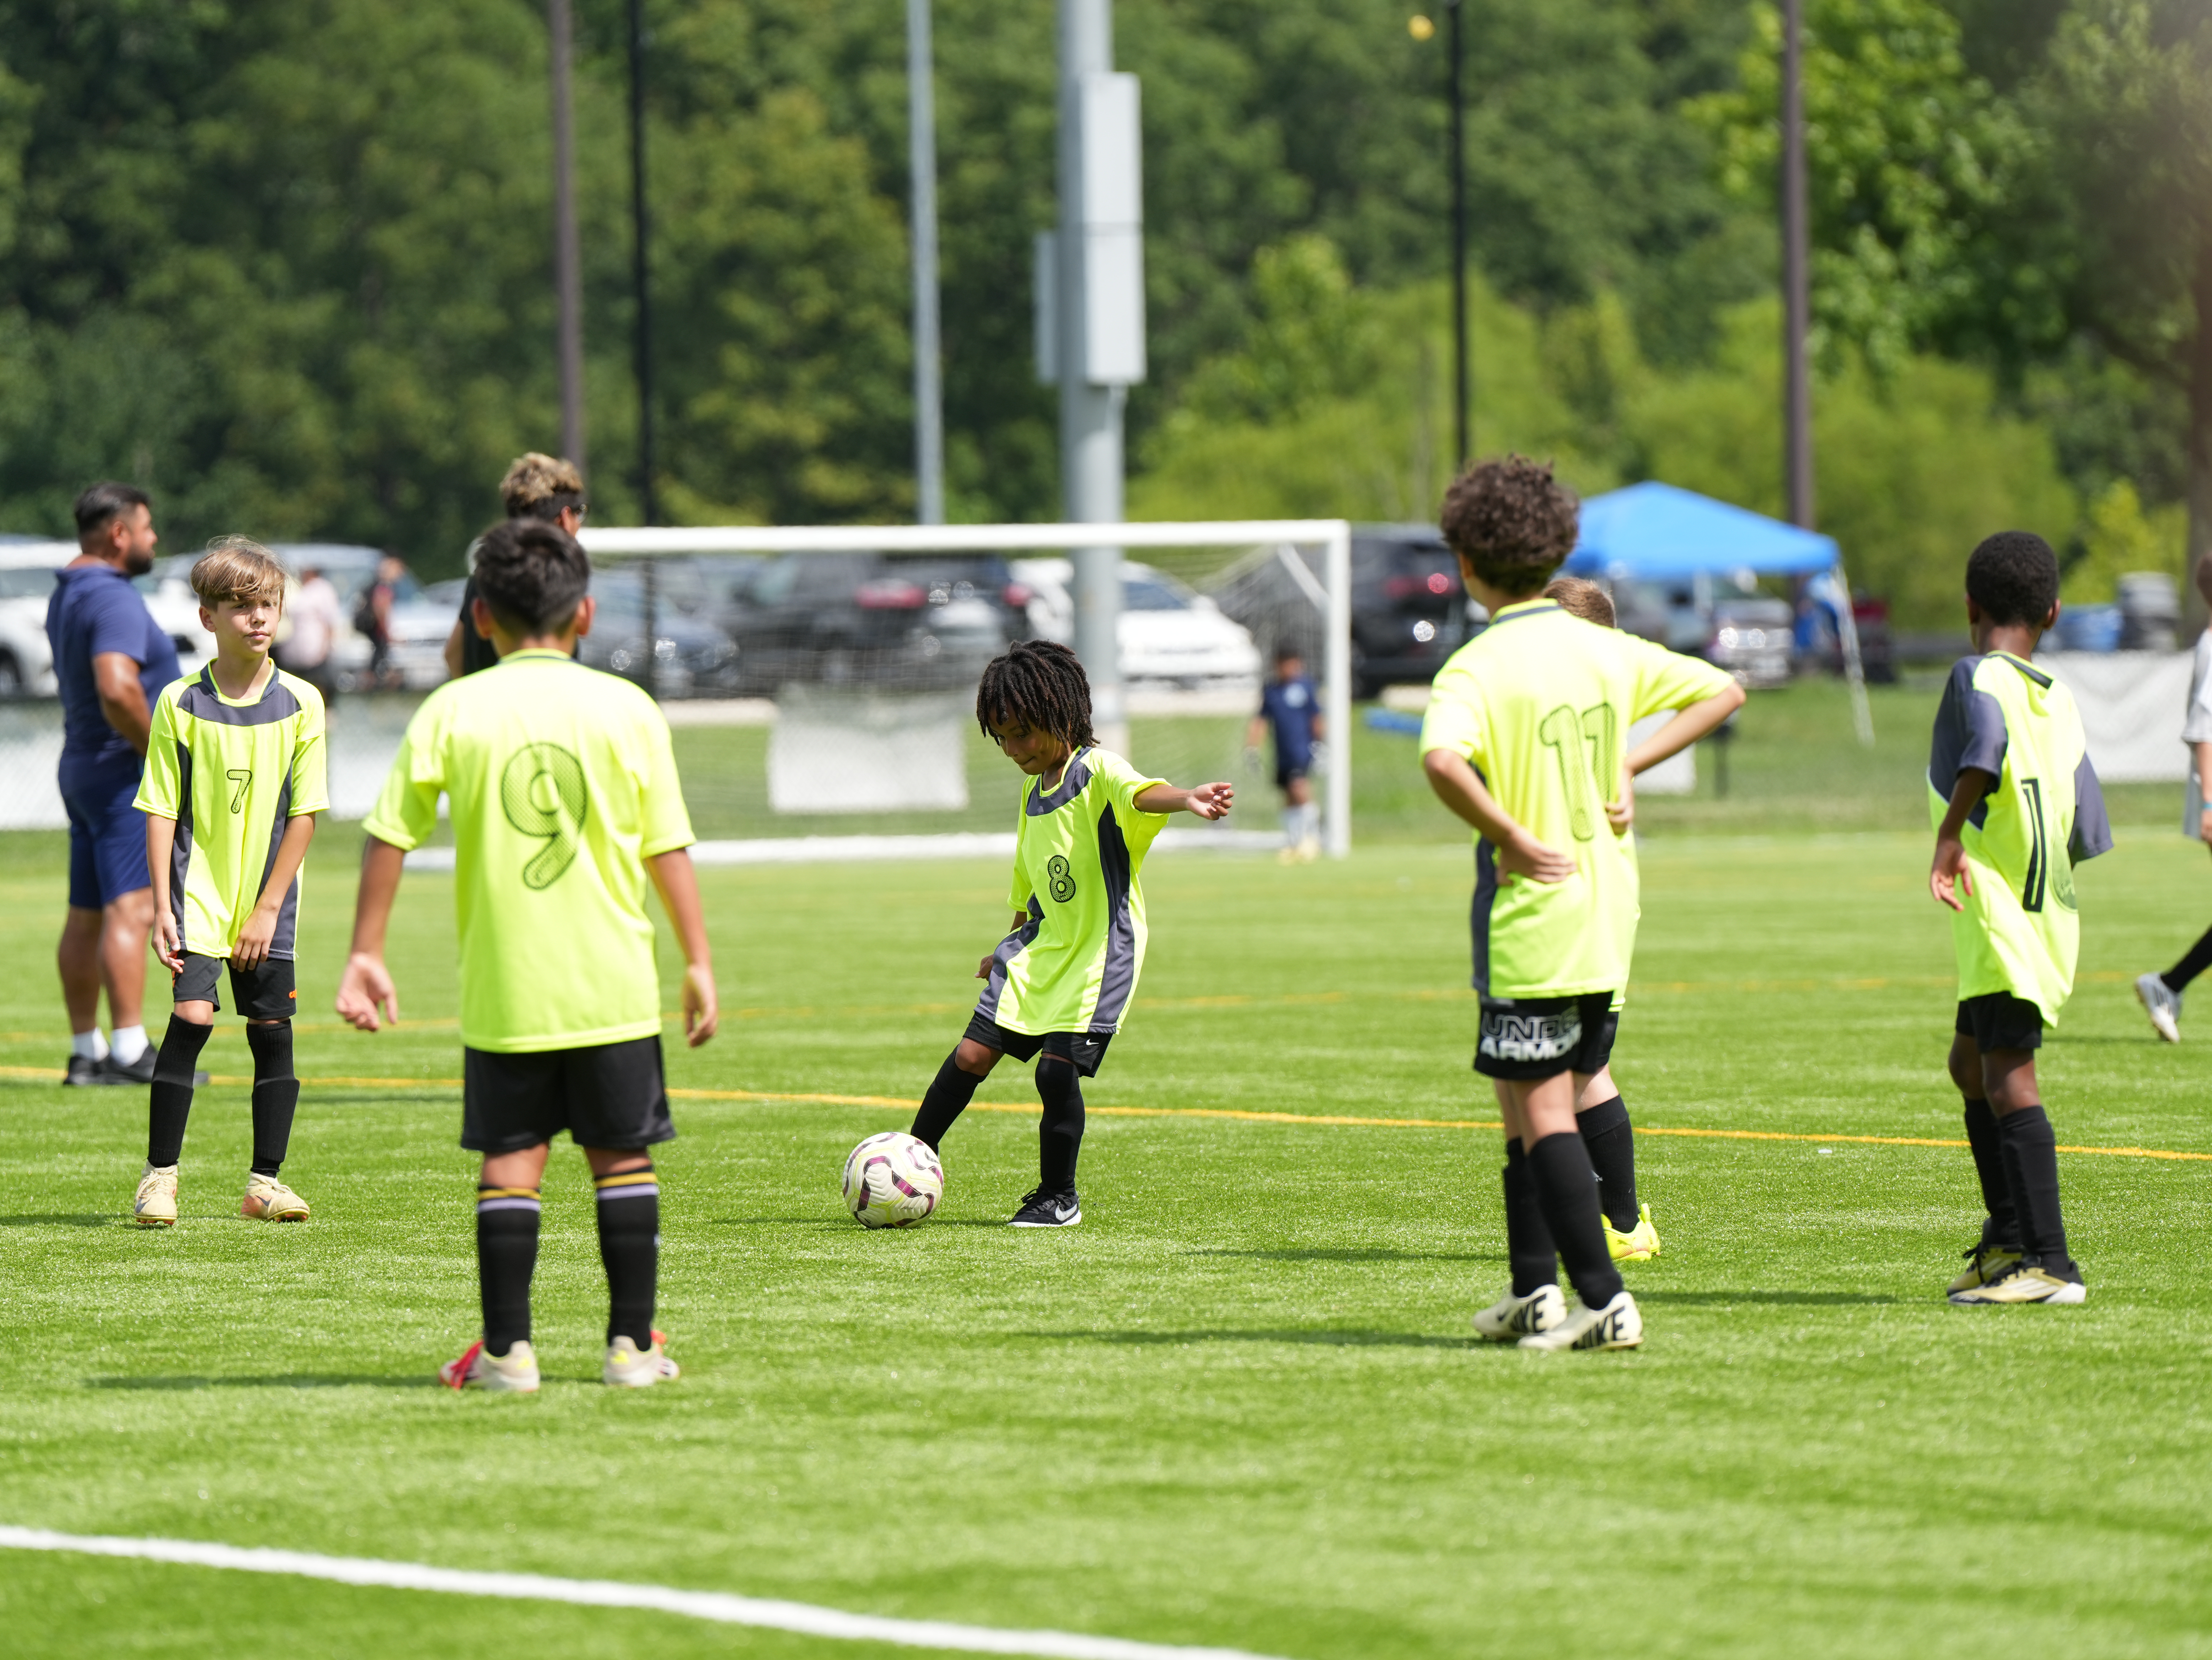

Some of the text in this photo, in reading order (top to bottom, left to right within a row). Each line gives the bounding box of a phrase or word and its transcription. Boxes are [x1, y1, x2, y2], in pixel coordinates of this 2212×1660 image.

[227, 769, 252, 814] 7
[501, 742, 587, 890] 9
[1539, 702, 1615, 841] 11
[1047, 855, 1076, 903] 8
